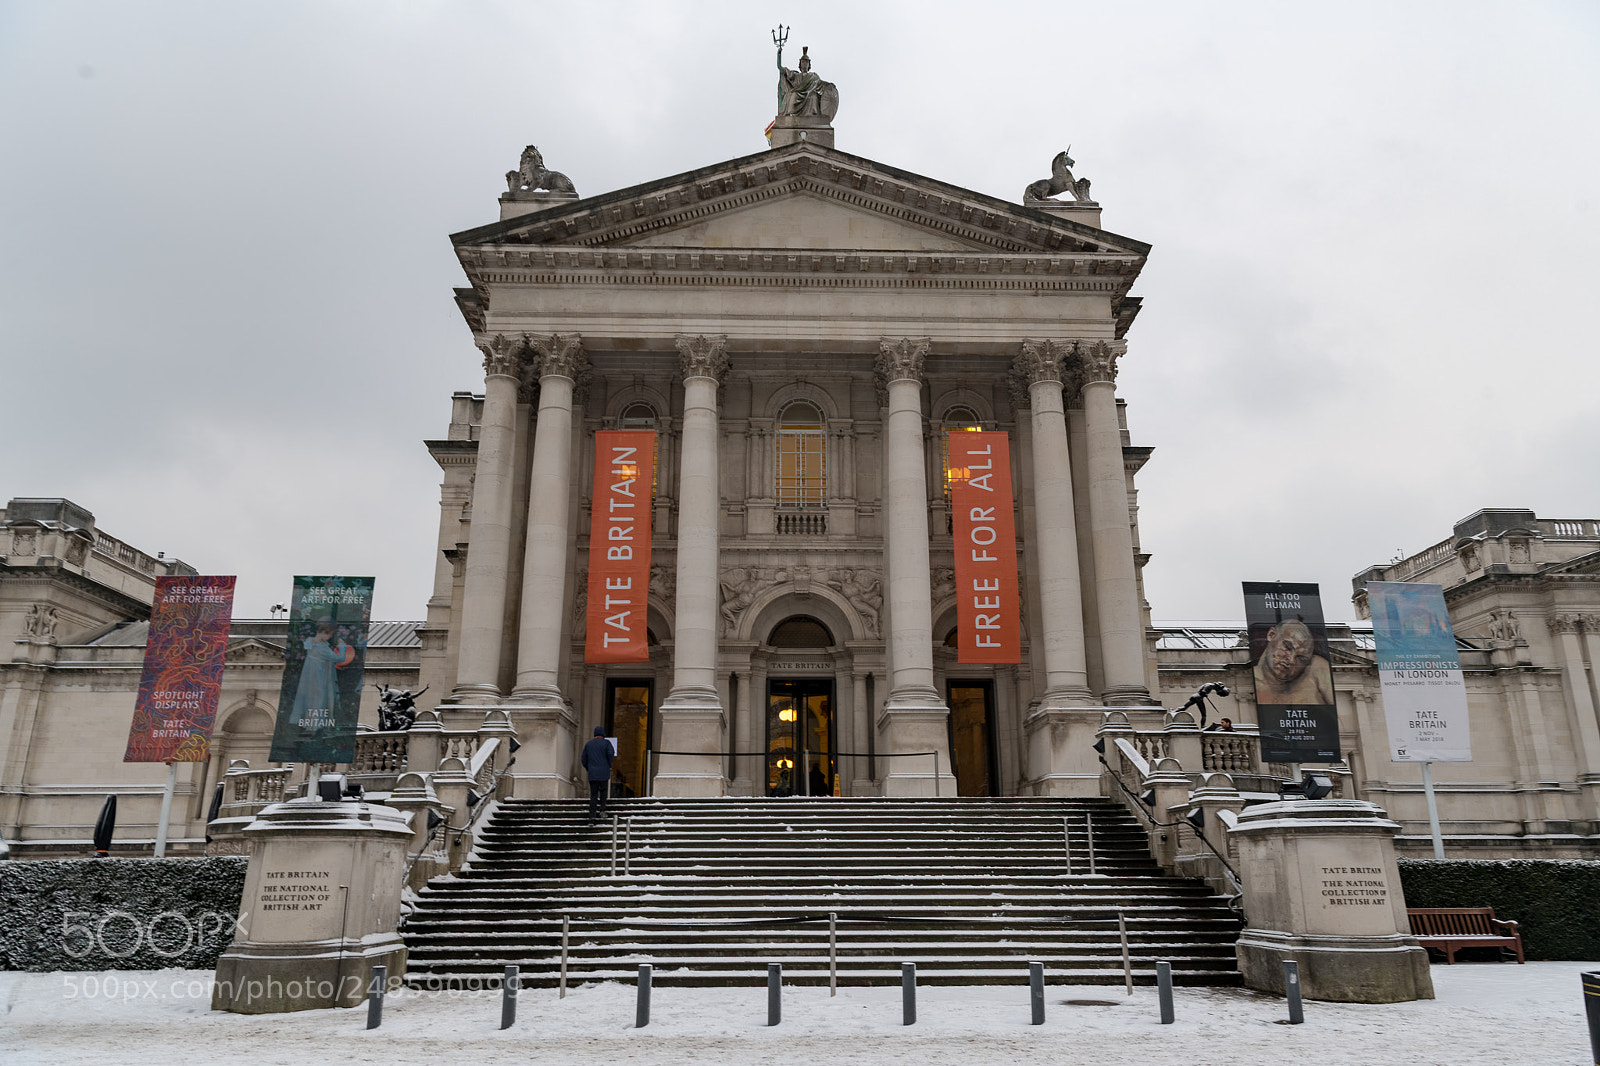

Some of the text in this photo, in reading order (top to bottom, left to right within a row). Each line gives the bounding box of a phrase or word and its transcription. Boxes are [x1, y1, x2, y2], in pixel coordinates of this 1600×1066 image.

[603, 447, 638, 648] TATE BRITAIN
[966, 443, 1002, 648] FREE FOR ALL
[171, 586, 219, 594] SEE GREAT
[310, 586, 358, 595] SEE GREAT
[162, 595, 225, 604] ART FOR FREE
[301, 595, 364, 605] ART FOR FREE
[1264, 592, 1300, 601] ALL TOO
[1265, 601, 1301, 609] HUMAN
[1380, 661, 1459, 670] IMPRESSIONISTS
[1394, 670, 1449, 679] IN LONDON
[153, 691, 205, 700] SPOTLIGHT
[155, 700, 199, 709] DISPLAYS
[307, 708, 329, 717] TATE
[1285, 709, 1308, 718] TATE
[1416, 711, 1438, 719] TATE
[163, 719, 185, 728] TATE
[298, 718, 336, 727] BRITAIN
[1279, 719, 1317, 728] BRITAIN
[1409, 720, 1447, 729] BRITAIN
[152, 729, 190, 738] BRITAIN
[287, 871, 330, 879] BRITAIN
[1345, 880, 1385, 888] NATIONAL
[261, 894, 316, 902] COLLECTION
[263, 903, 323, 911] BRITISH ART
